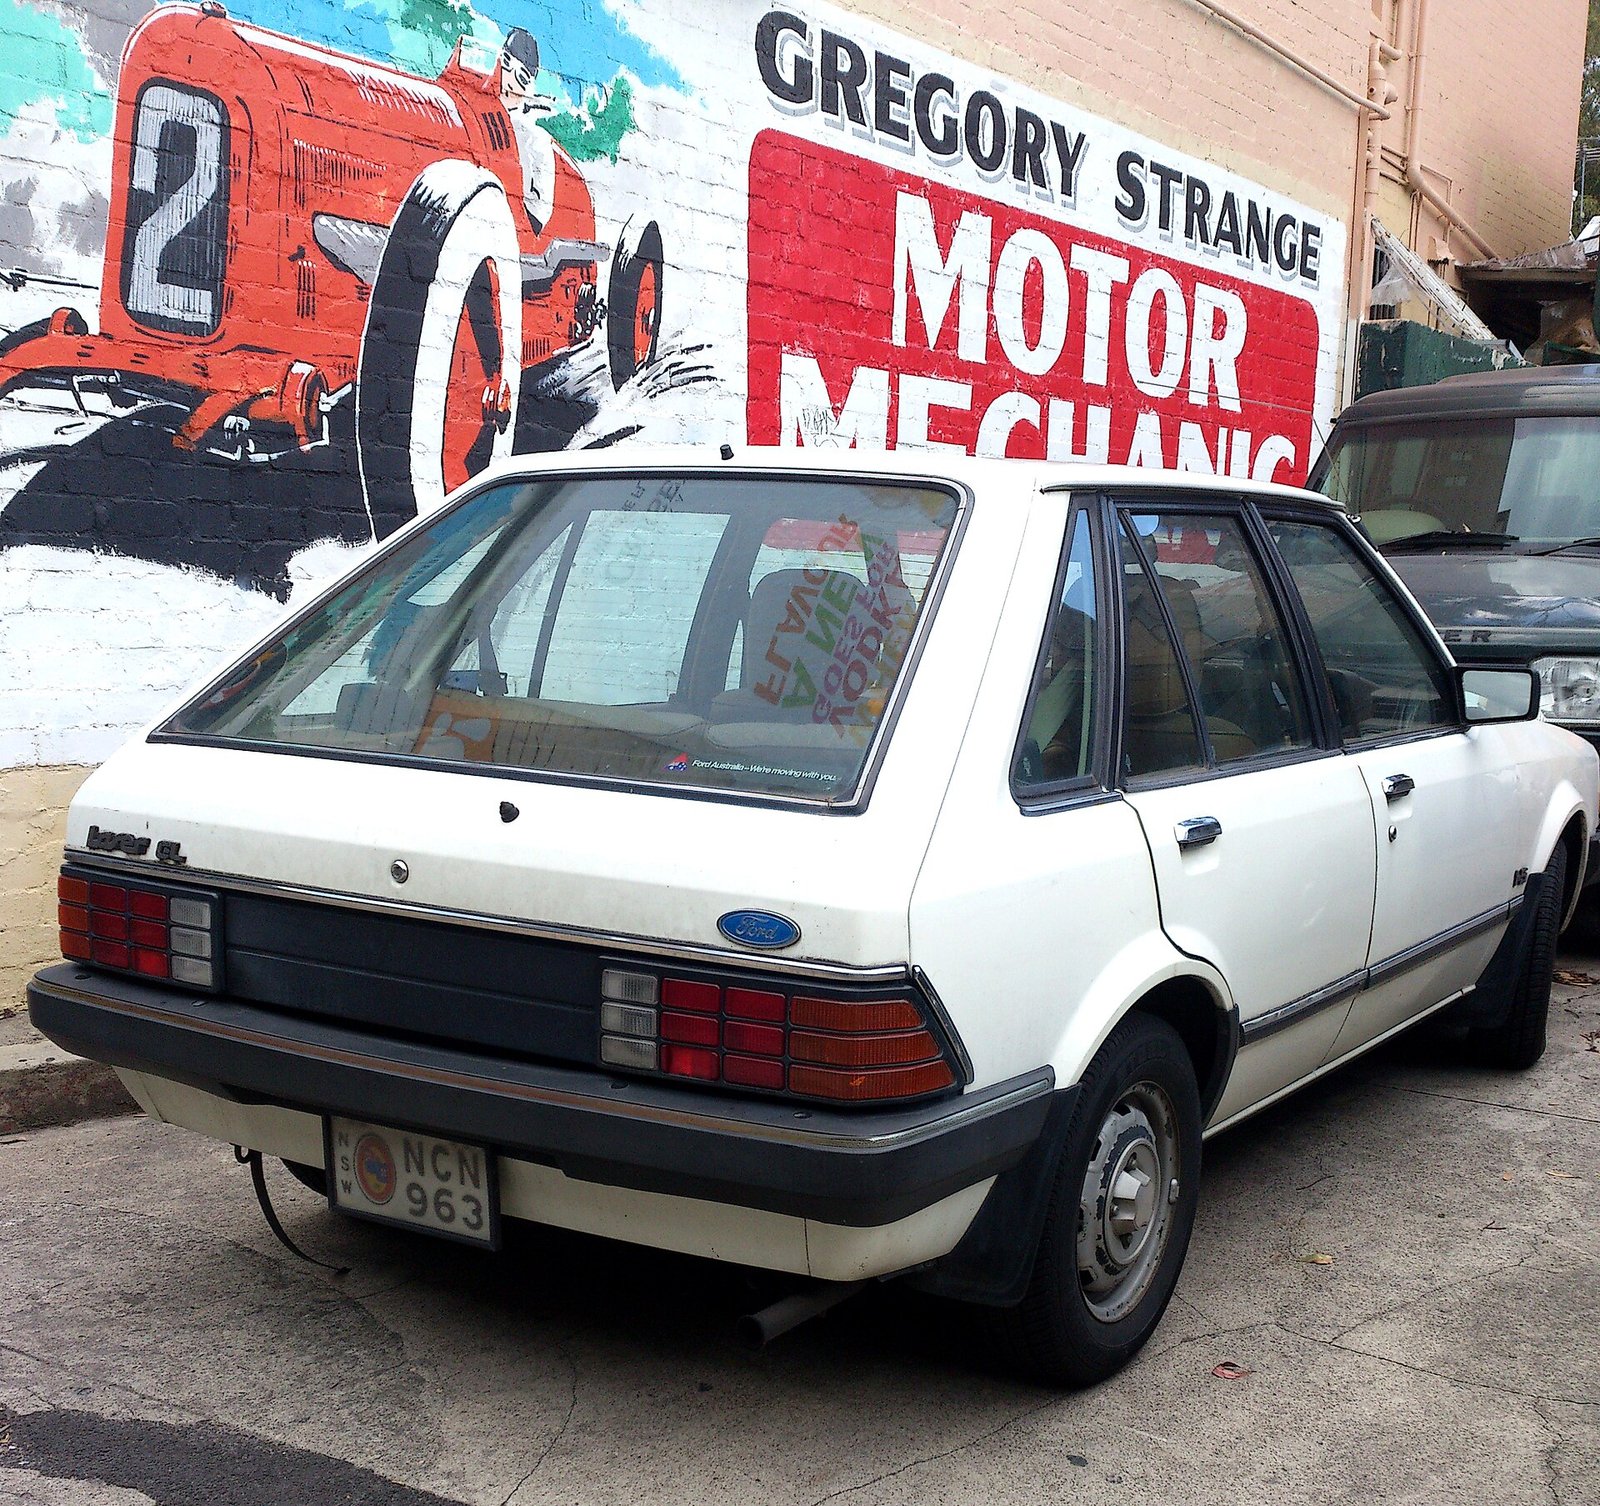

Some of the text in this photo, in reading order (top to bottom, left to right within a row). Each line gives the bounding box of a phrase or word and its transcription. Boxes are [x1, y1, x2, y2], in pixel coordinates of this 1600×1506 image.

[754, 10, 1321, 284] GREGORY STRANGE
[127, 85, 222, 327] 2
[891, 190, 1249, 414] MOTOR
[692, 759, 711, 768] Ford
[711, 761, 746, 771] Australia
[771, 768, 802, 779] moving
[802, 771, 820, 779] with
[735, 915, 779, 940] Ford
[402, 1136, 482, 1190] NCN
[405, 1182, 484, 1231] 963
